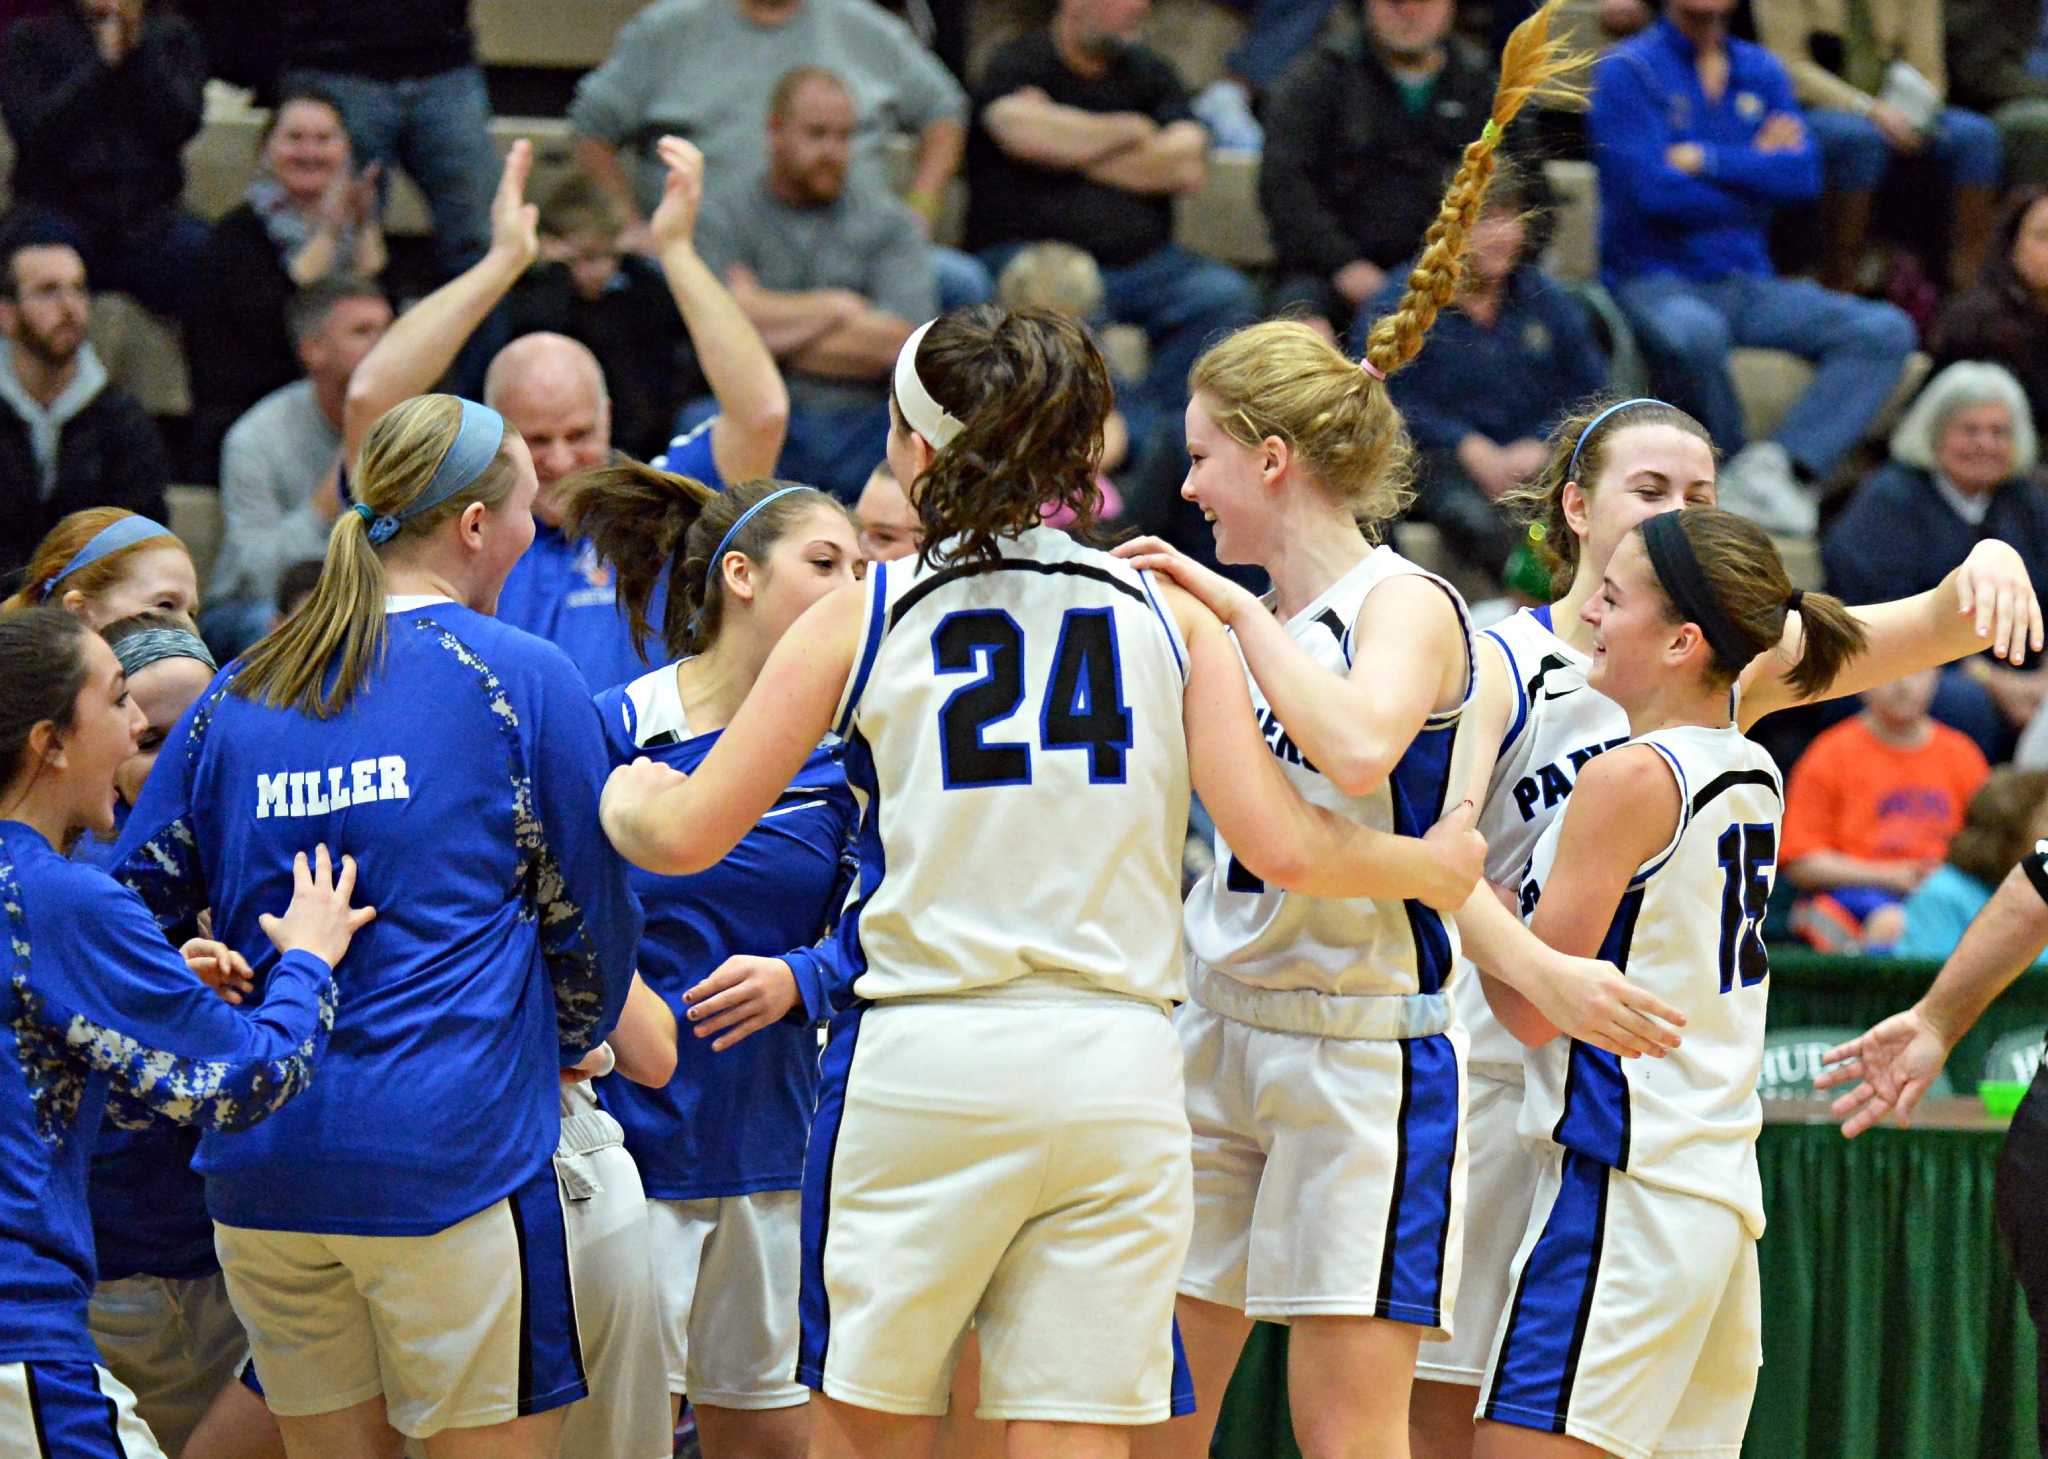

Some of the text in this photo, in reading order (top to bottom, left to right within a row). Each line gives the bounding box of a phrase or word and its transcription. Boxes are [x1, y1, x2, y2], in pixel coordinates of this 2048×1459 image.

[930, 606, 1133, 790] 24
[256, 755, 410, 819] MILLER
[1717, 822, 1776, 994] 15
